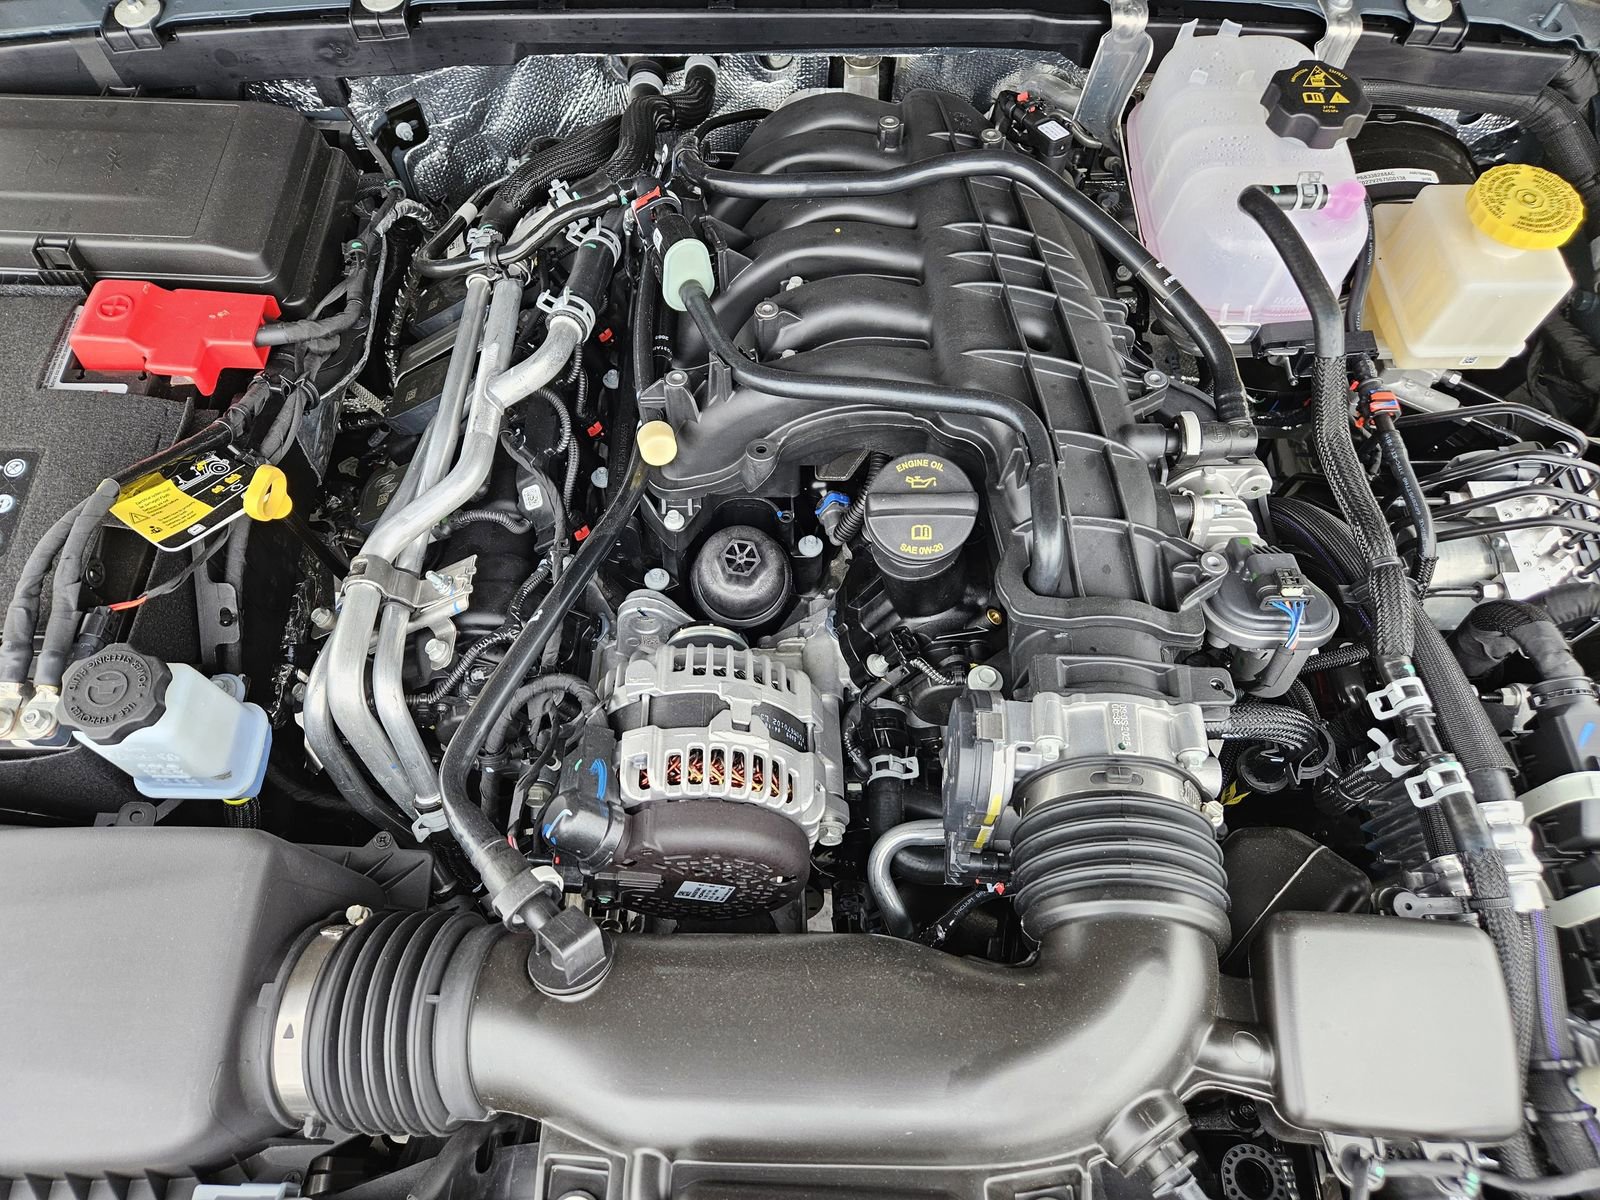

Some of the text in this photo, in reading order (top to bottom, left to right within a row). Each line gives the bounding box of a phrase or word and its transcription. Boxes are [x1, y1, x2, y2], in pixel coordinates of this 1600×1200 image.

[895, 459, 945, 473] ENGINE OIL
[899, 543, 944, 555] SAE 0W-20
[69, 653, 148, 690] POWER STEERING FLUID
[70, 701, 137, 724] USE APPROVED
[953, 897, 976, 916] VACUUM
